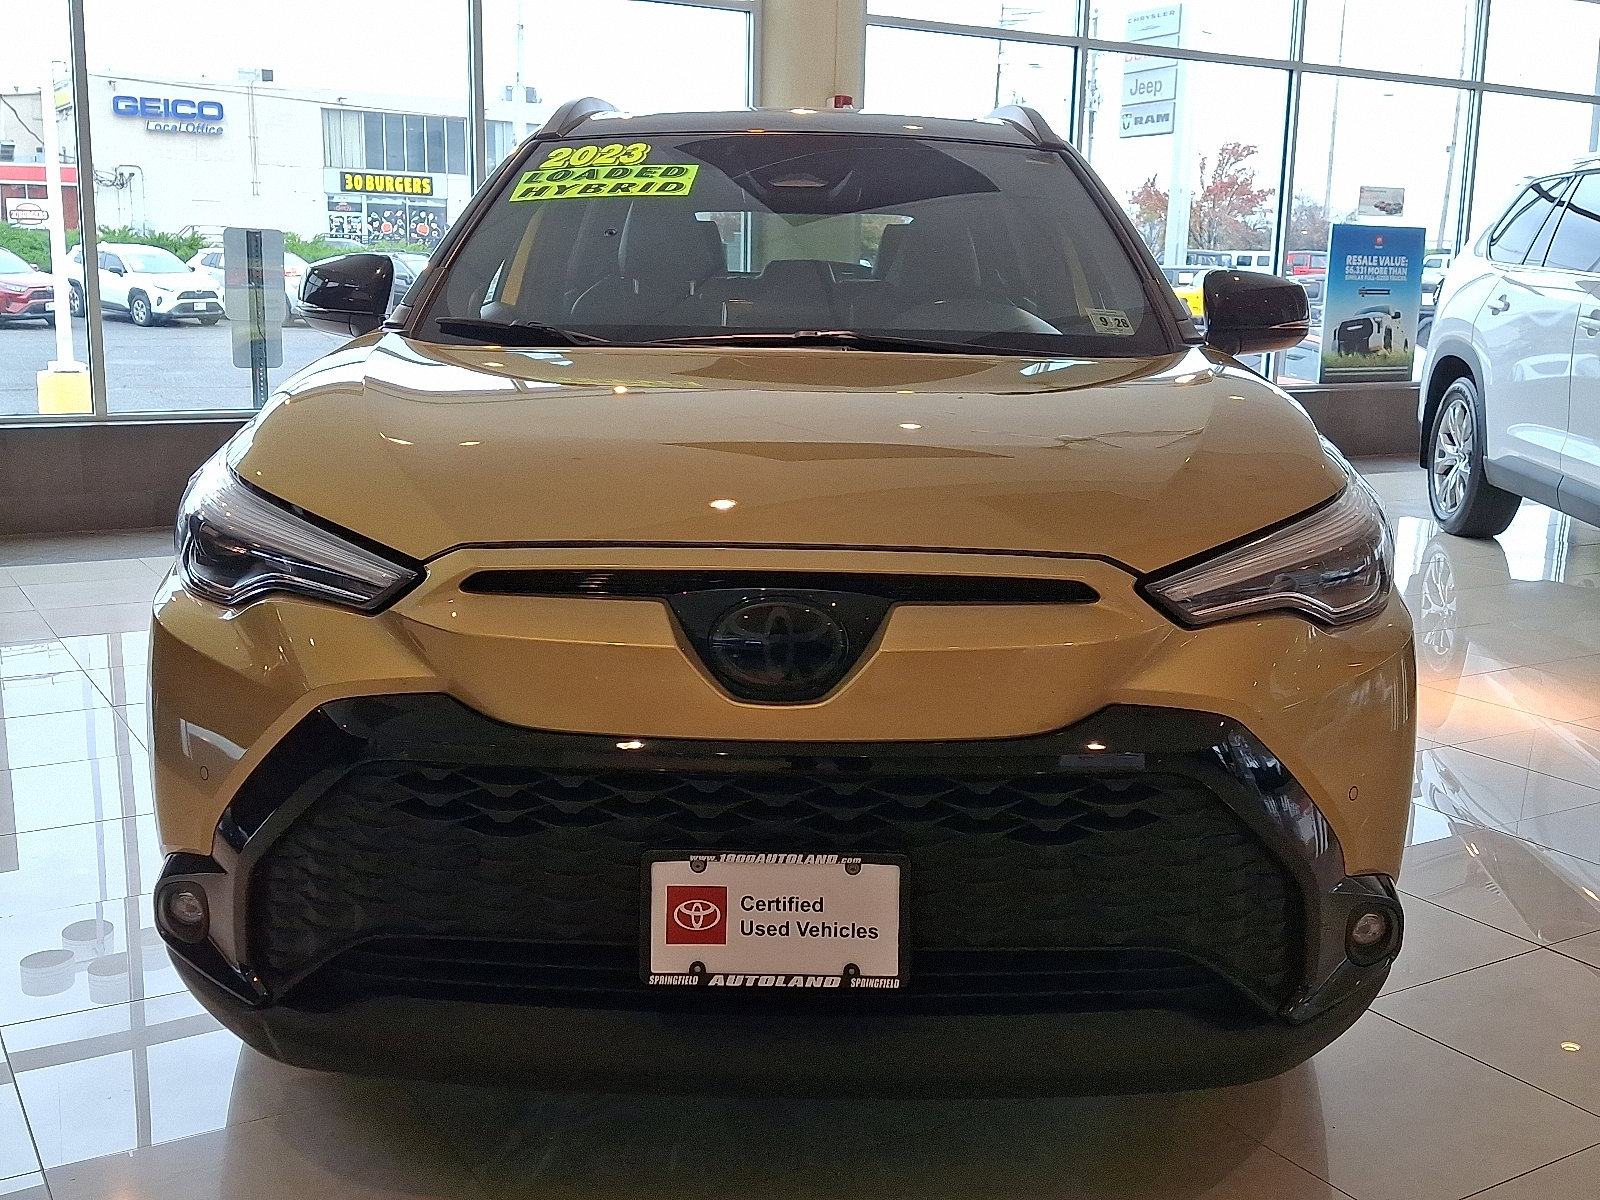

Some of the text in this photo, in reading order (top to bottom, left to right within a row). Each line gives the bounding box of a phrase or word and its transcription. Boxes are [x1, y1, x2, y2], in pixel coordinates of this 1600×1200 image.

[1128, 10, 1175, 24] CHRYSLER
[1129, 79, 1163, 96] Jeep
[113, 95, 224, 121] GEICO
[1134, 113, 1170, 126] RAM
[145, 120, 224, 135] Local Office
[539, 142, 652, 170] 2023
[523, 165, 689, 185] LOADED
[344, 173, 431, 195] 30 BURGERS
[517, 181, 687, 199] HYBRID
[1346, 255, 1409, 267] RESALE VALUE:
[1367, 267, 1388, 275] MORE
[1388, 267, 1408, 276] THAN
[1100, 316, 1130, 328] 9 28
[740, 896, 824, 912] Certified
[740, 920, 879, 939] Used Vehicles
[649, 975, 699, 985] SPRINGFIELD
[707, 975, 842, 988] AUTOLAND
[850, 977, 900, 989] SPRINGFIELD
